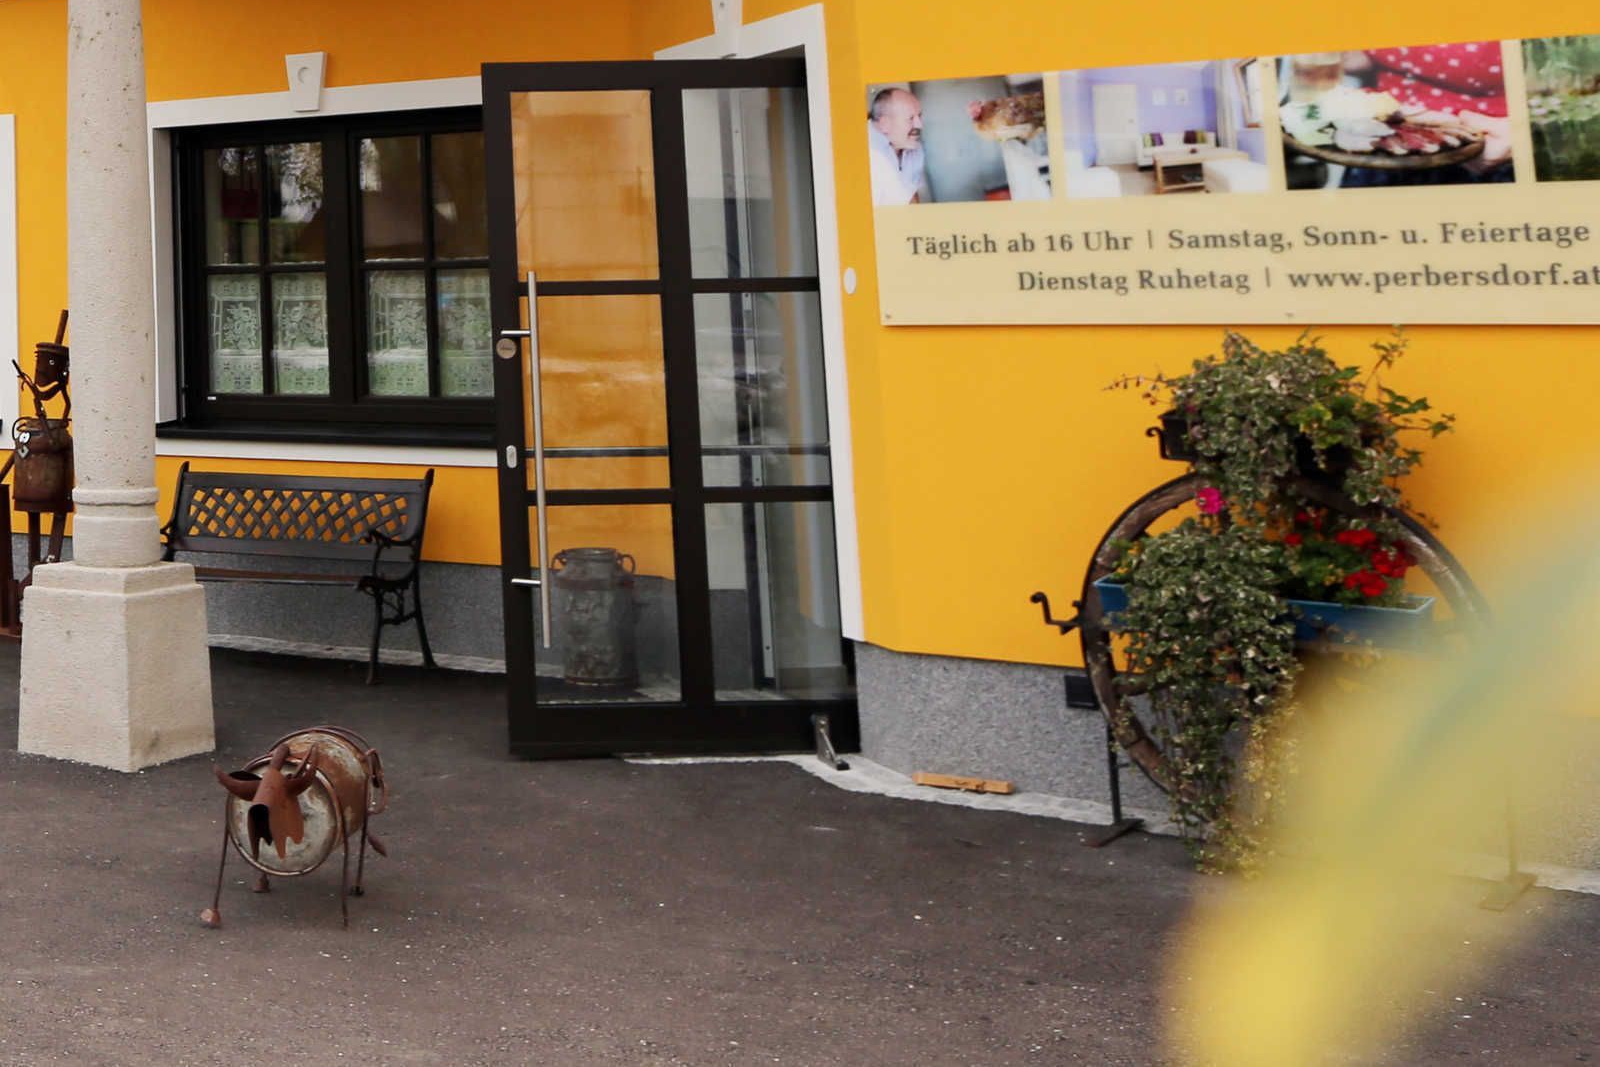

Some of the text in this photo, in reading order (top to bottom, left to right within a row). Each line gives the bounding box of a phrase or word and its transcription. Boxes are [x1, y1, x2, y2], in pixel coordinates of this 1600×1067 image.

[907, 221, 1591, 260] Täglich ab 16 Uhr Samstag, Sonn- u. Feiertage
[1017, 262, 1600, 296] Dienstag Ruhetag www.perbersdorf.at
